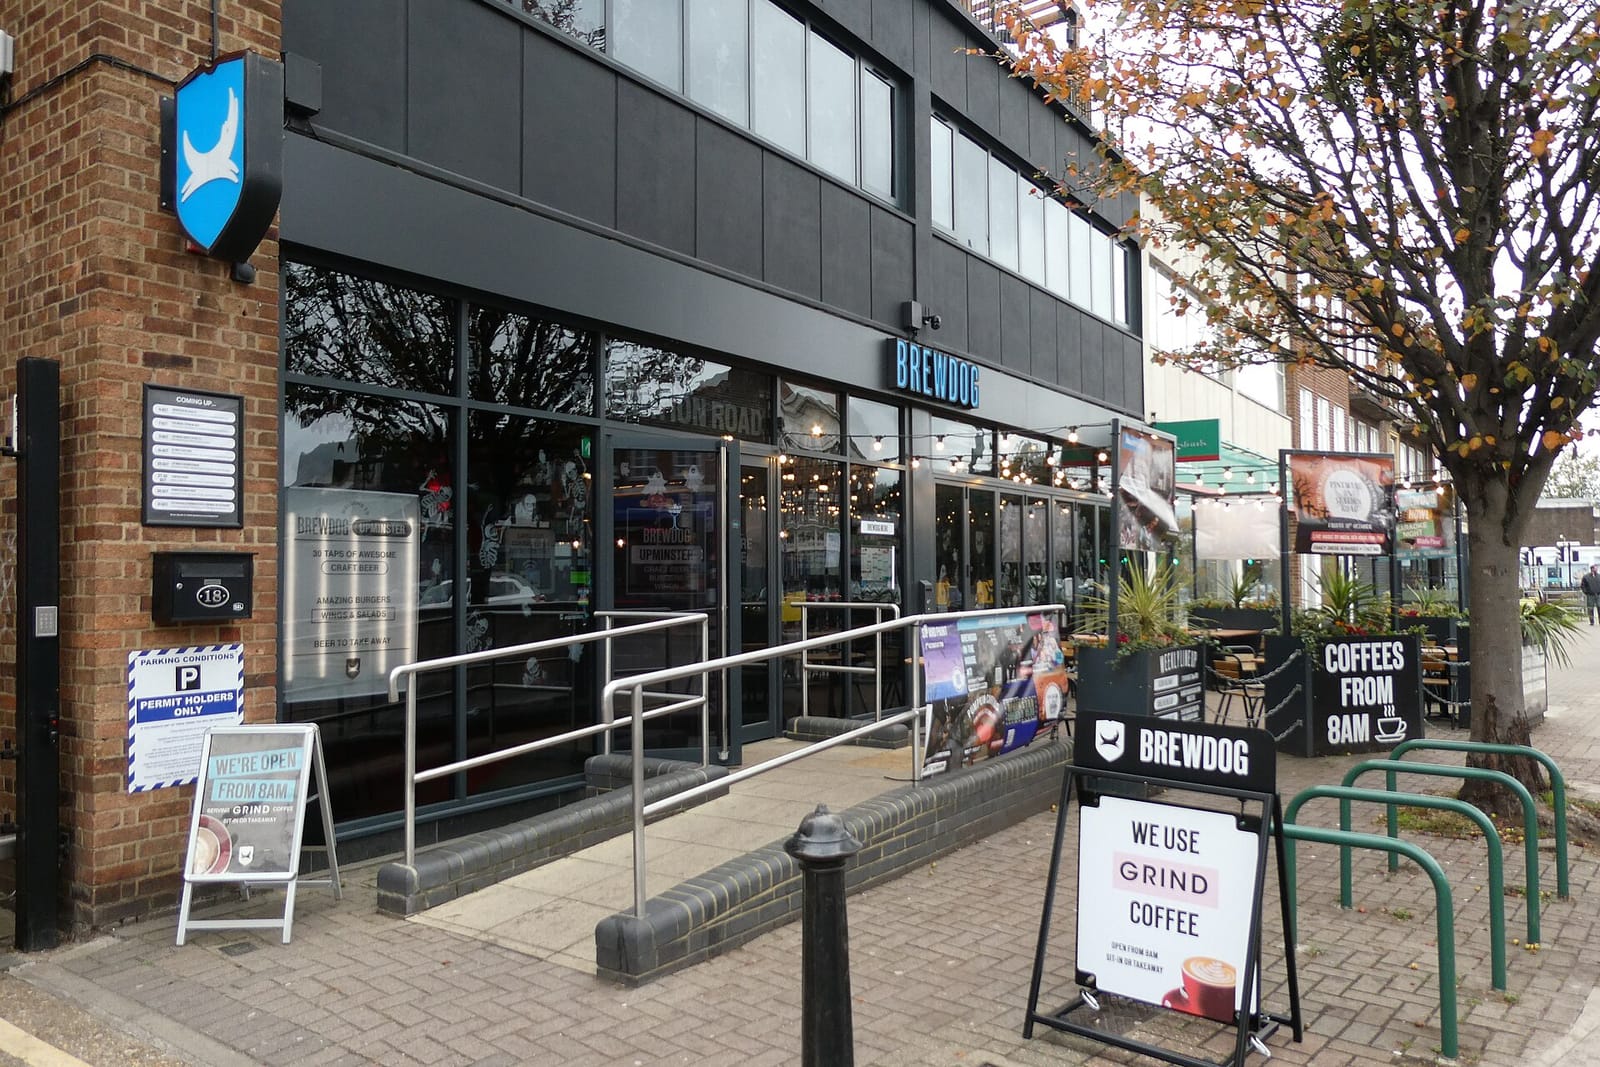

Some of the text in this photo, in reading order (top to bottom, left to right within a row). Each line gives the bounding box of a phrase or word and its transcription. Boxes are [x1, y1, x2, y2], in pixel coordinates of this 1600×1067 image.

[896, 338, 979, 408] BREWDOG
[176, 396, 202, 405] COMING
[711, 401, 764, 436] ROAD
[297, 517, 407, 536] BREWDOG UPMINSTER
[643, 528, 690, 543] BREWDOG
[312, 549, 397, 559] 30 TAPS OF AWESOME
[330, 564, 379, 572] CRAFT BEER
[204, 589, 222, 602] 18
[316, 595, 391, 605] AMAZING BURGERS
[321, 611, 348, 619] WINGS
[356, 610, 387, 618] SALADS
[314, 637, 391, 648] BEER TO TAKE AWAY
[140, 653, 235, 666] PARKING CONDITIONS
[1325, 641, 1404, 673] COFFEES
[181, 667, 198, 690] P
[1340, 675, 1393, 706] FROM
[140, 692, 234, 710] PERMIT HOLDERS
[174, 705, 203, 716] ONLY
[1327, 713, 1370, 744] 8AM
[1139, 728, 1249, 776] BREWDOG
[216, 751, 297, 776] WE'RE OPEN
[218, 782, 288, 799] FROM 8AM
[232, 805, 270, 815] GRIND
[1132, 820, 1200, 854] WE USE
[1120, 861, 1208, 895] GRIND
[1130, 901, 1199, 937] COFFEE
[1111, 941, 1159, 959] OPEN FROM 8AM
[1106, 953, 1163, 973] SIT-IN OR TAKEAWAY
